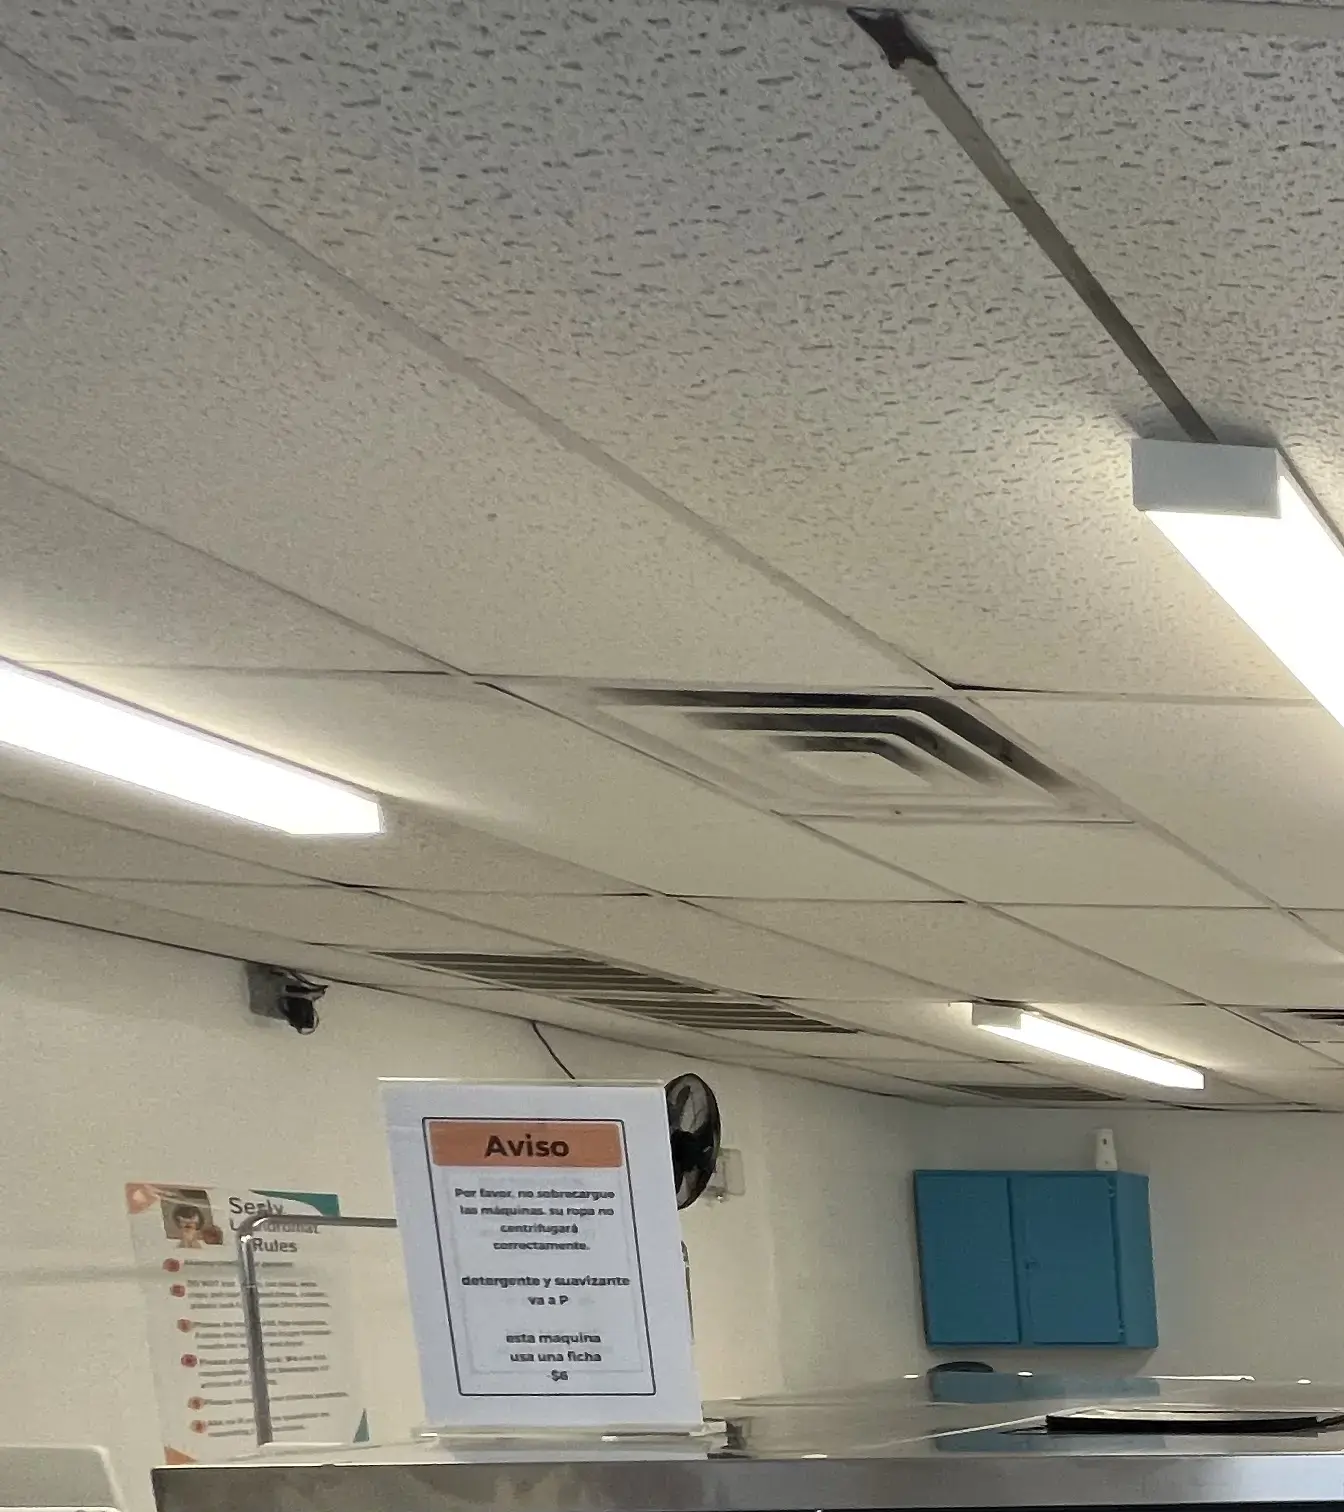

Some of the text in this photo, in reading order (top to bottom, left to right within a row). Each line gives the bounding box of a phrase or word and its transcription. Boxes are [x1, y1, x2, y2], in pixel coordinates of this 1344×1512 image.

[484, 1133, 570, 1158] Aviso
[455, 1188, 477, 1198] Por
[518, 1190, 534, 1198] no
[537, 1189, 615, 1201] sobrecargue
[460, 1205, 478, 1215] las
[549, 1207, 564, 1215] su
[566, 1207, 595, 1217] ropa
[598, 1207, 615, 1216] no
[252, 1237, 297, 1252] Rules
[462, 1275, 630, 1288] detergente y suavizante
[528, 1295, 569, 1306] va a P
[506, 1333, 535, 1343] esta
[510, 1351, 602, 1362] usa una ficha
